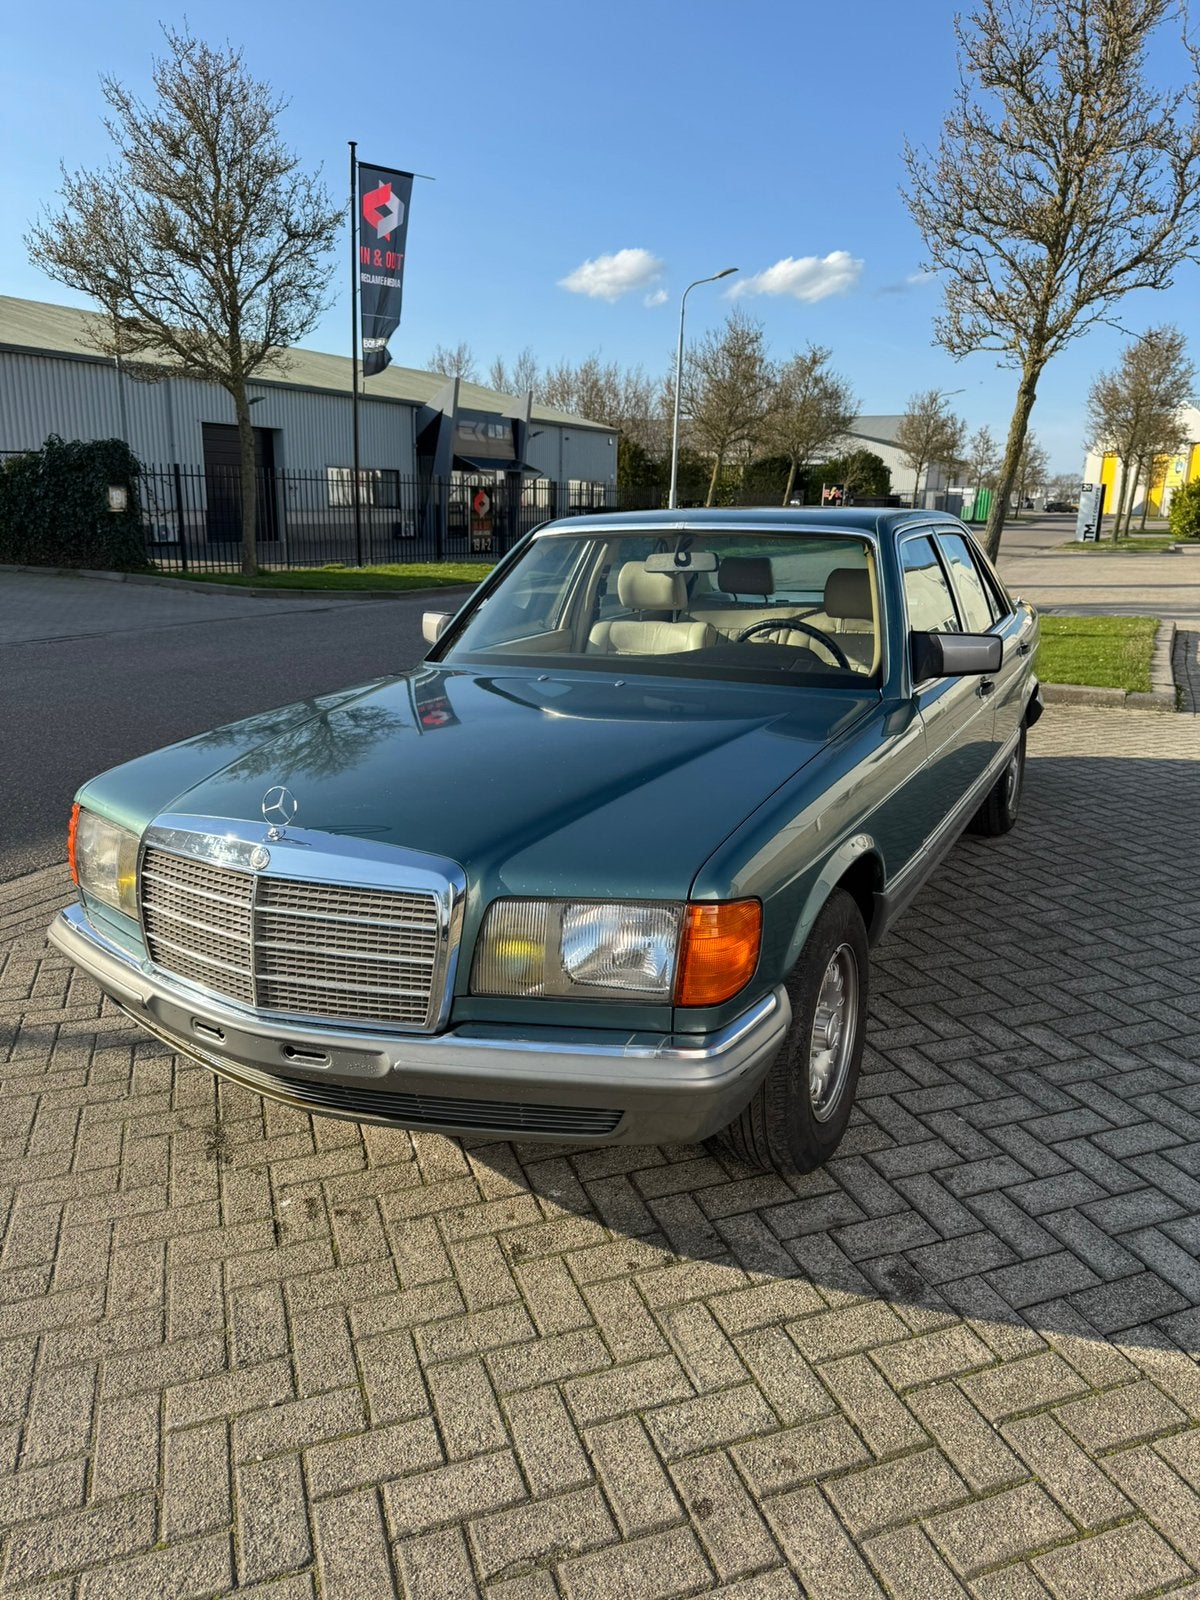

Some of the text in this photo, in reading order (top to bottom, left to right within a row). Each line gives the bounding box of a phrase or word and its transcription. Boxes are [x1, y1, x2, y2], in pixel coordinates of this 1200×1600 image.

[360, 246, 404, 270] IN & OUT
[1083, 523, 1096, 541] TM
